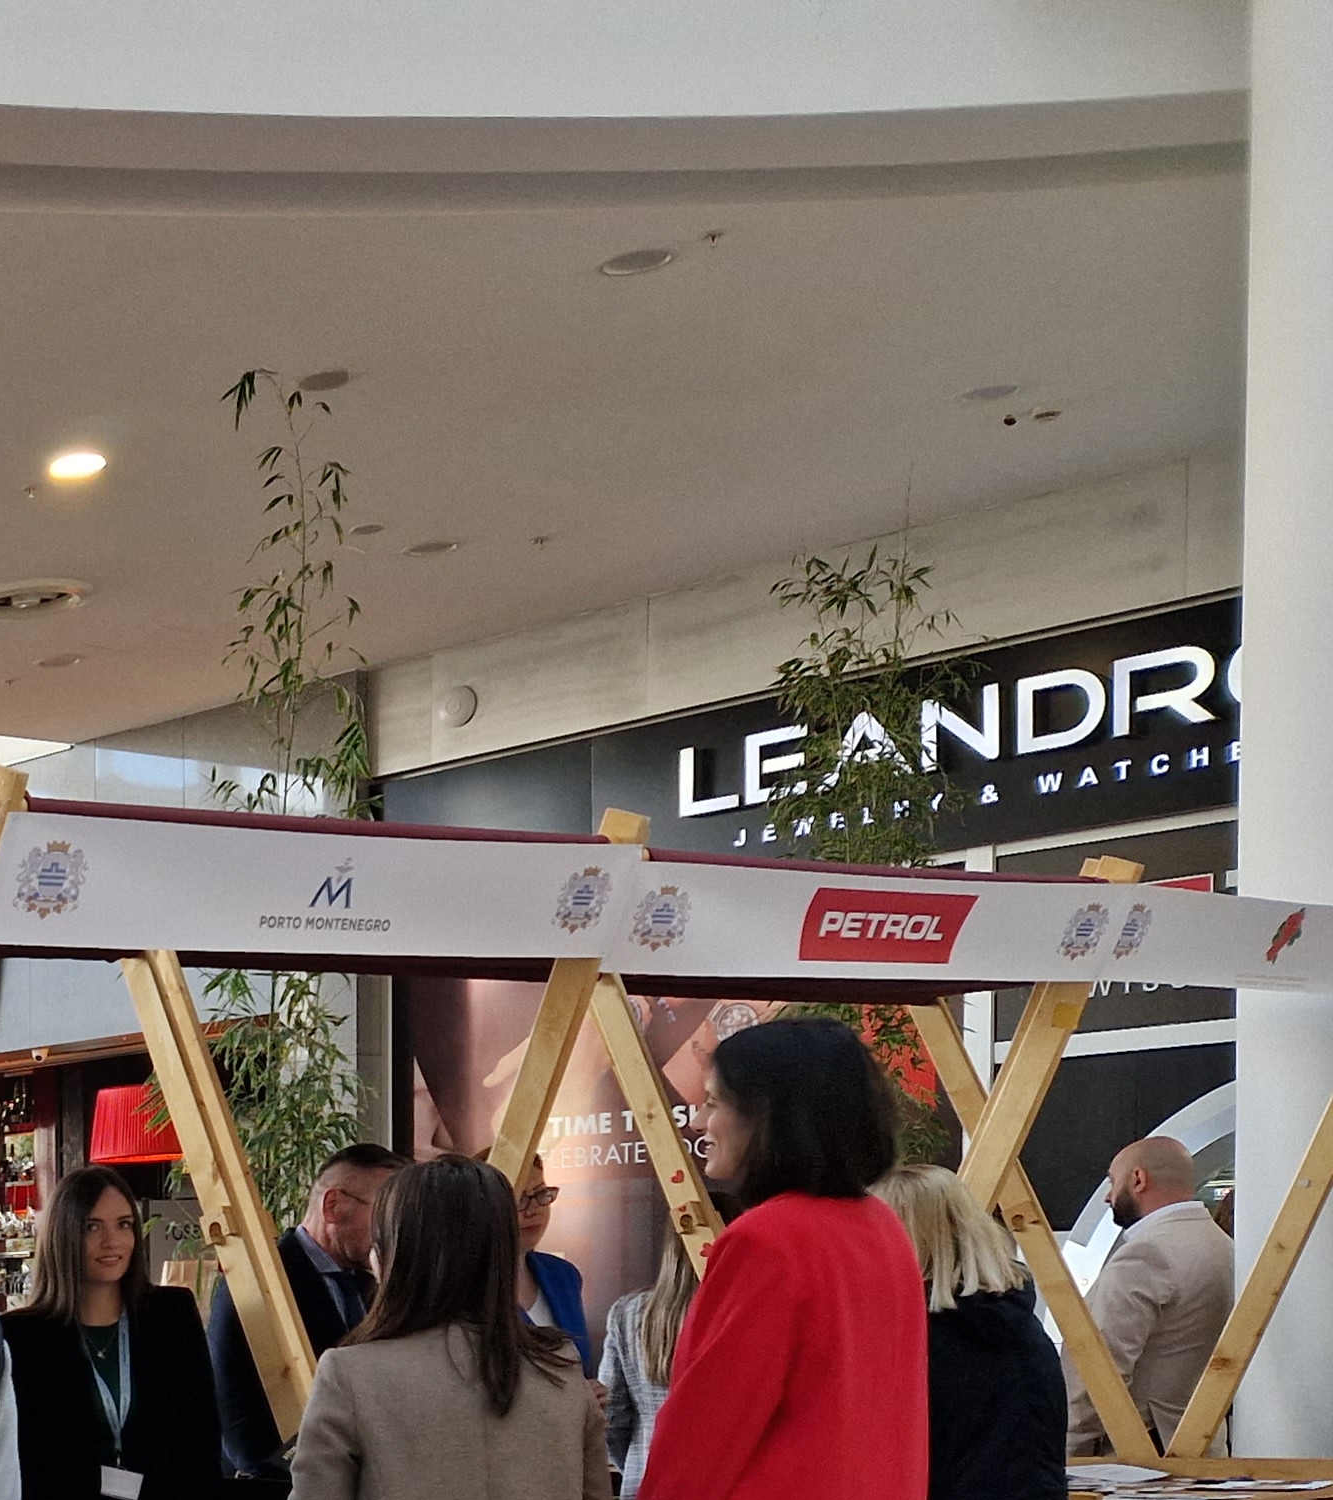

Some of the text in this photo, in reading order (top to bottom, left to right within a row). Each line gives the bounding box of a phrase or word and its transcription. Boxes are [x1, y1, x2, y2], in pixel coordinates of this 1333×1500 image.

[678, 645, 1242, 818] LEANDR
[980, 783, 1000, 805] &
[259, 914, 392, 932] PORTO MONTENEGRO
[818, 910, 945, 942] PETROL
[548, 1112, 613, 1138] TIME
